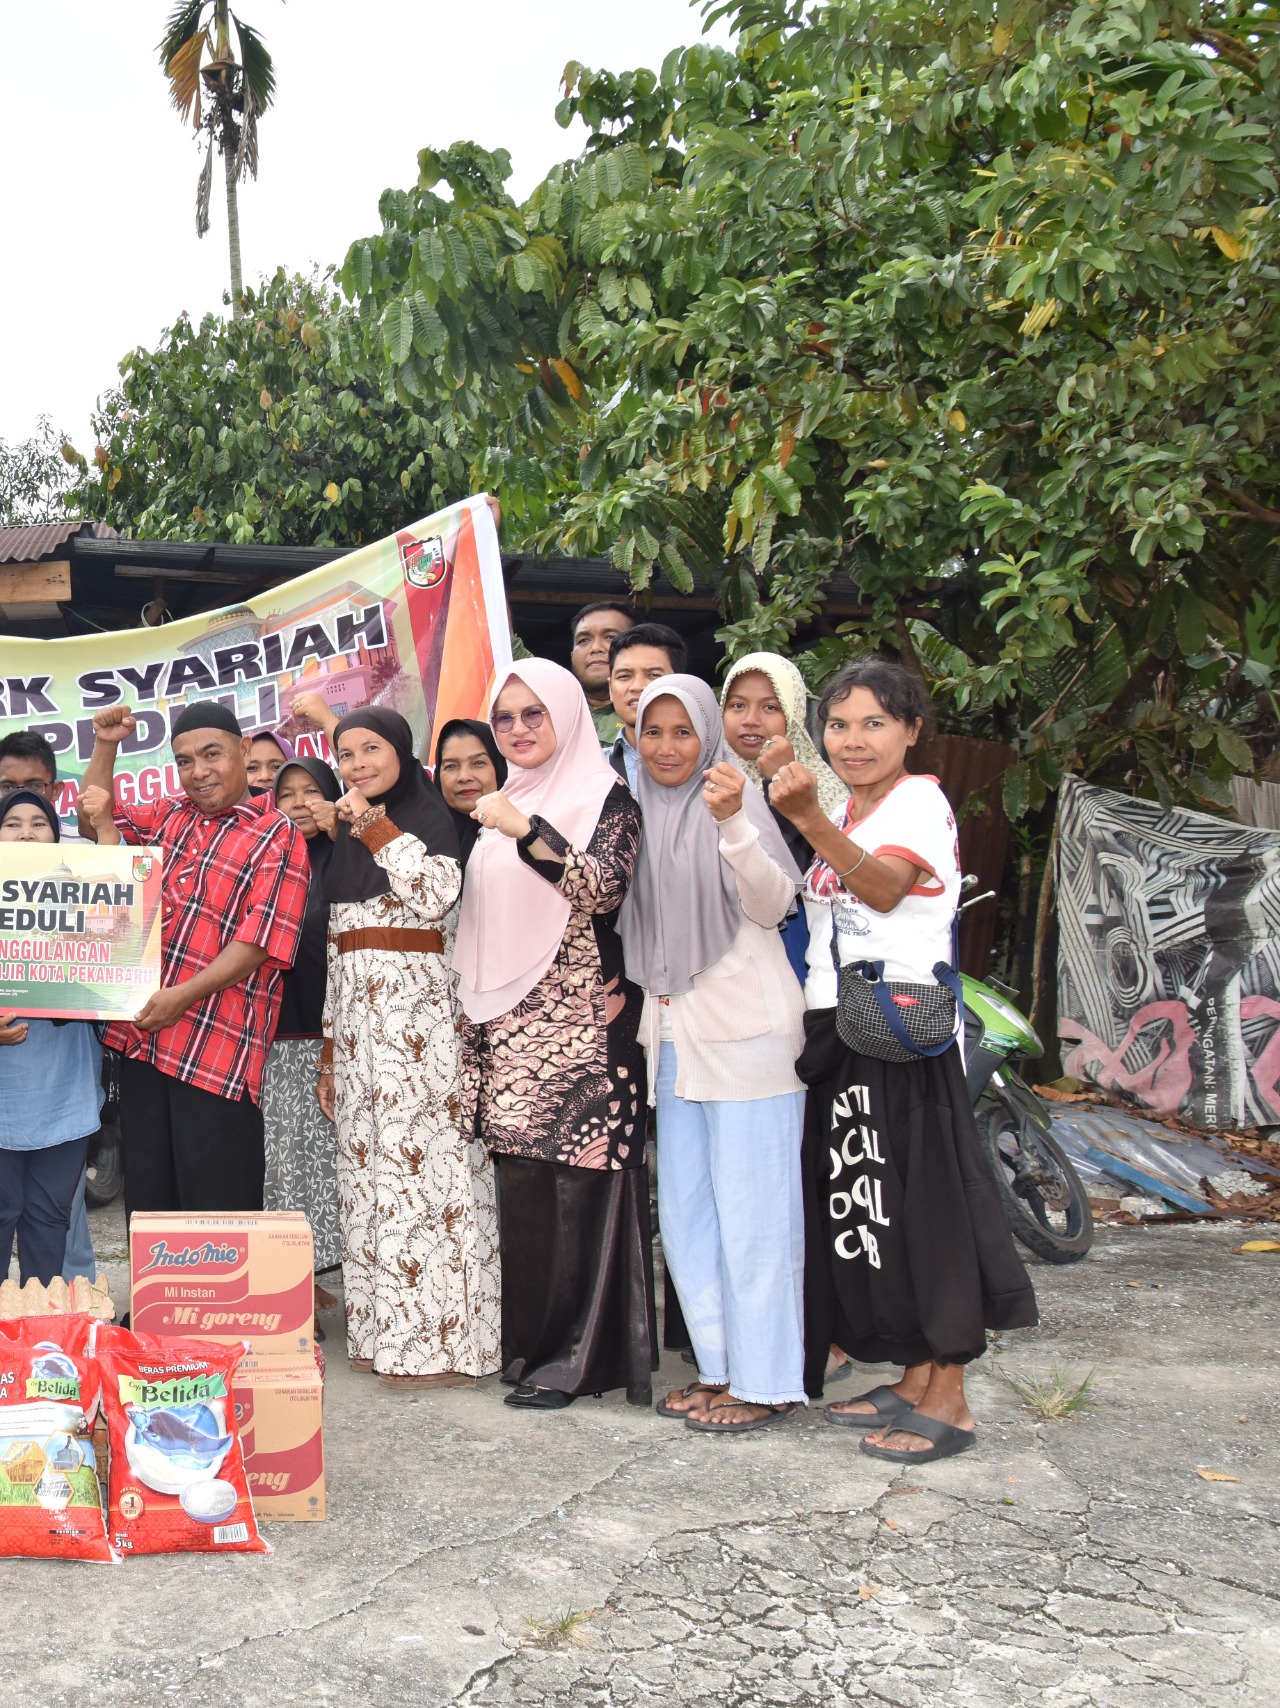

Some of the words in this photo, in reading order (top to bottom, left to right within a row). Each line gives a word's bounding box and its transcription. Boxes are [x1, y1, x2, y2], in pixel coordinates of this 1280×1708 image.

[77, 602, 388, 708] SYARIAH
[1, 879, 135, 906] SYARIAH
[29, 964, 65, 982] KOTA
[69, 965, 153, 984] PEKANBARU
[1202, 997, 1218, 1089] PERINGATAN:
[831, 1085, 871, 1132] NTI
[164, 1286, 179, 1298] Mi
[180, 1286, 216, 1298] Instan
[162, 1307, 200, 1325] Mi
[199, 1311, 283, 1331] goreng
[138, 1365, 165, 1375] BERAS
[165, 1361, 209, 1373] PREMIUM
[37, 1380, 77, 1396] Belida
[141, 1383, 210, 1403] Belida
[129, 1496, 135, 1508] 1
